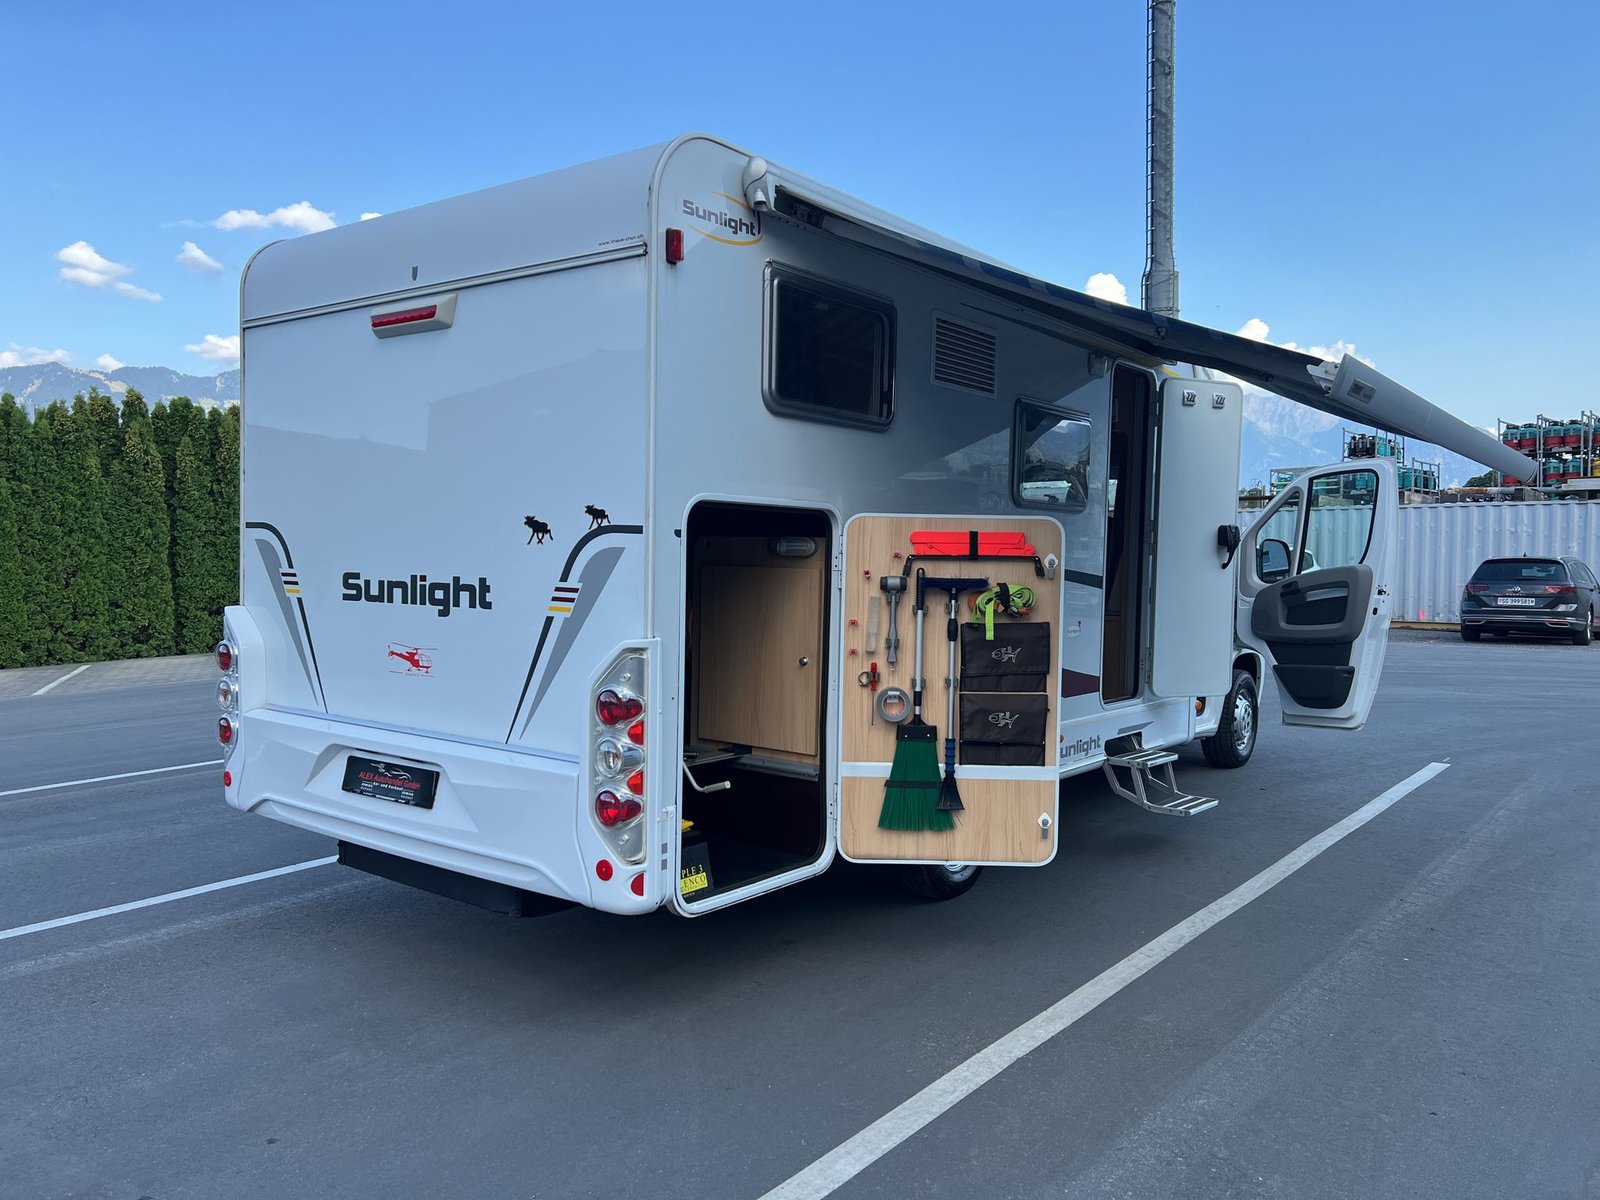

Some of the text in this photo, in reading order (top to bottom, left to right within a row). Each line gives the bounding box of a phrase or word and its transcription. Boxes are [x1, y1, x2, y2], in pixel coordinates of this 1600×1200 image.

[682, 199, 756, 237] Sunlight
[342, 571, 493, 618] Sunlight
[1060, 734, 1101, 758] unlight
[358, 771, 373, 780] ALEX
[374, 774, 404, 786] Autohandel
[403, 780, 421, 790] GmbH
[681, 866, 697, 878] PLE
